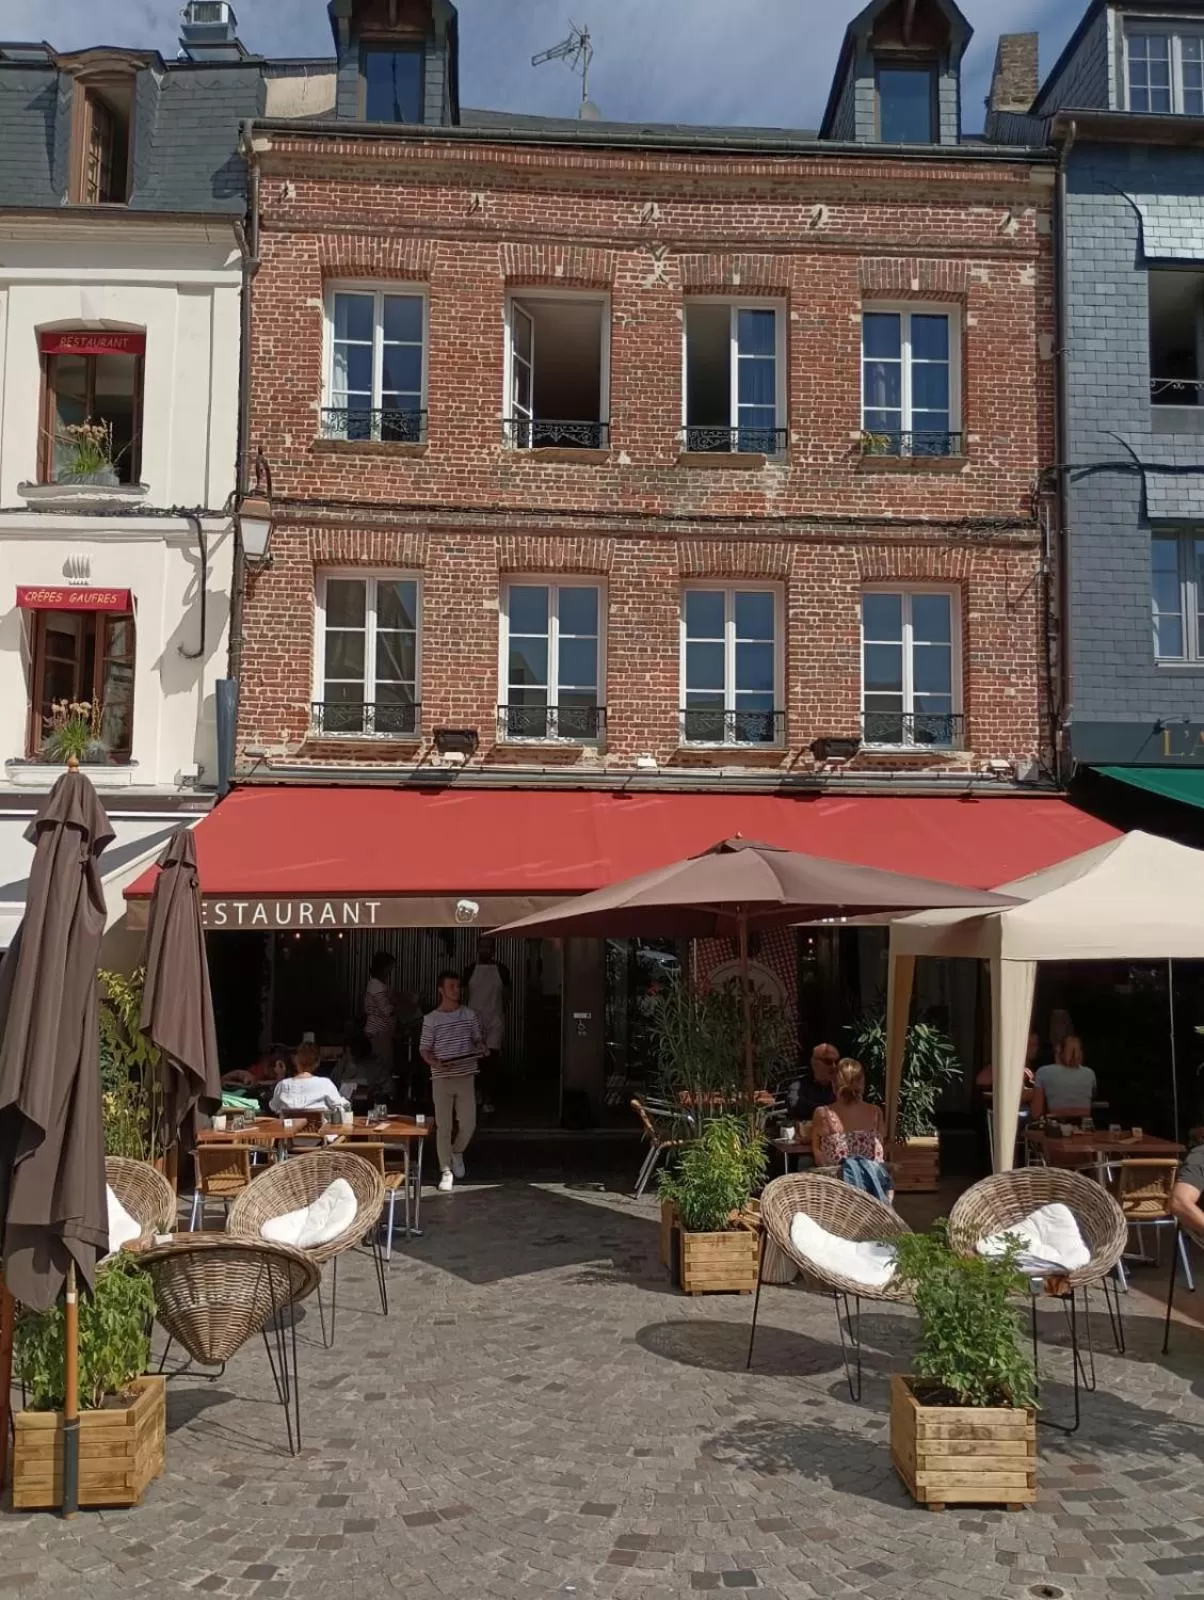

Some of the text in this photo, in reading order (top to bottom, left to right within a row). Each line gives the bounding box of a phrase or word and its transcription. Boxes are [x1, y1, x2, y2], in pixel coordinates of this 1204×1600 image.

[60, 336, 128, 349] RESTAURANT
[24, 588, 118, 605] CRÊPES GAUFRES
